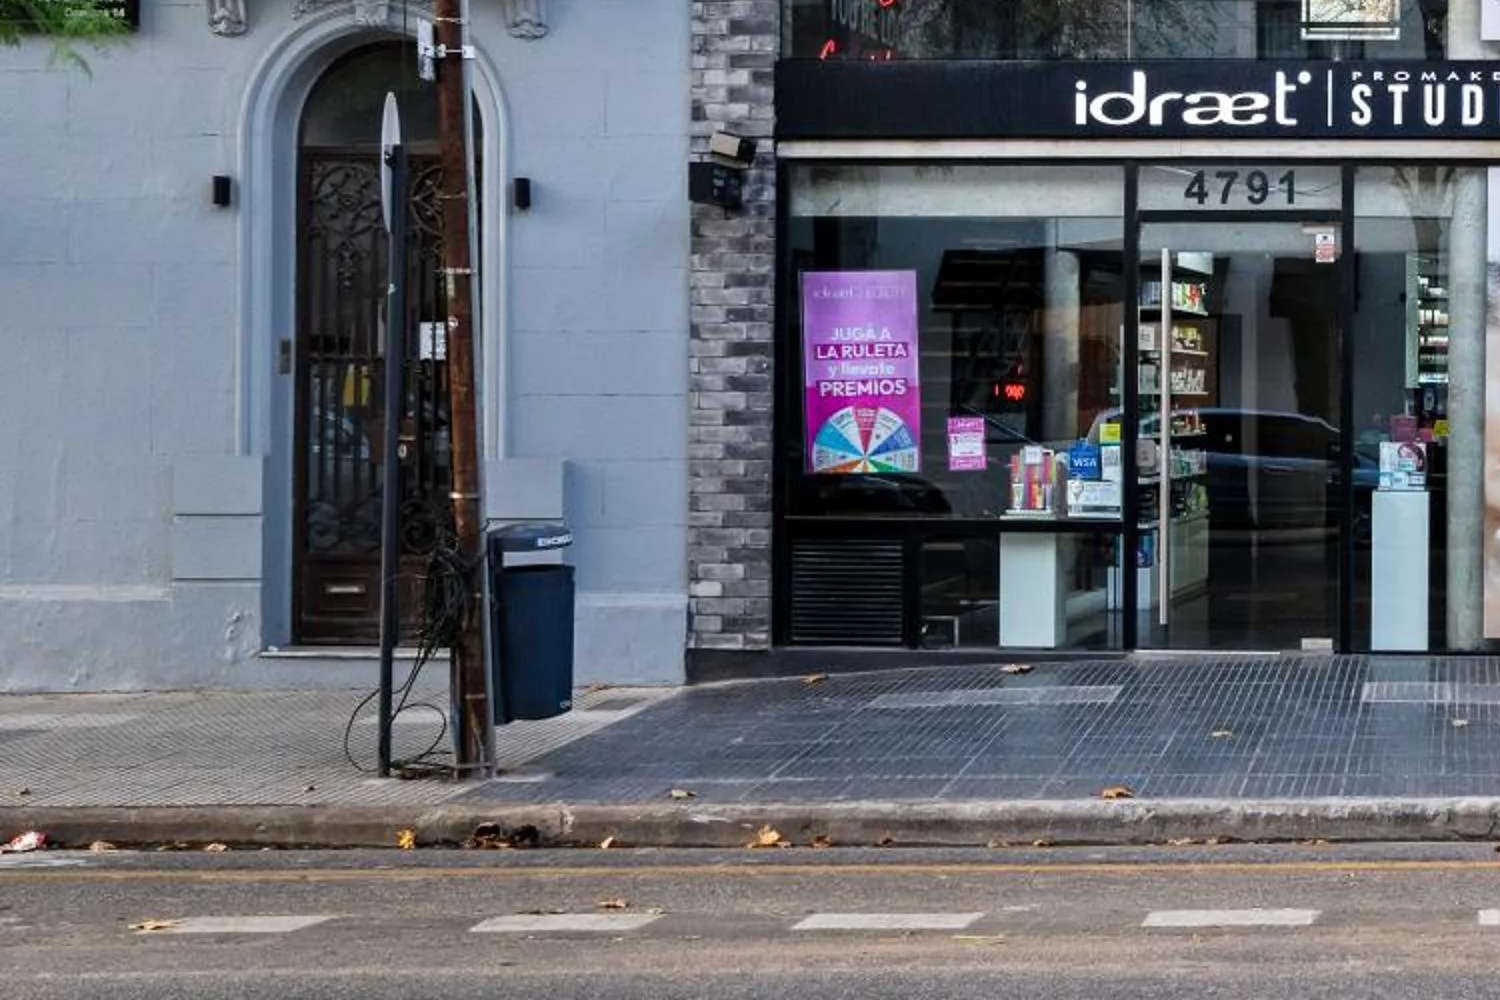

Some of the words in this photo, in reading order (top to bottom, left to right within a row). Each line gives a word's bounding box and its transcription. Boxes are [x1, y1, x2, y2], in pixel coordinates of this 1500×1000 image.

[1183, 169, 1297, 205] 4791
[880, 327, 893, 341] A
[816, 346, 840, 360] LA
[841, 344, 908, 359] RULETA
[820, 379, 907, 398] PREMIOS
